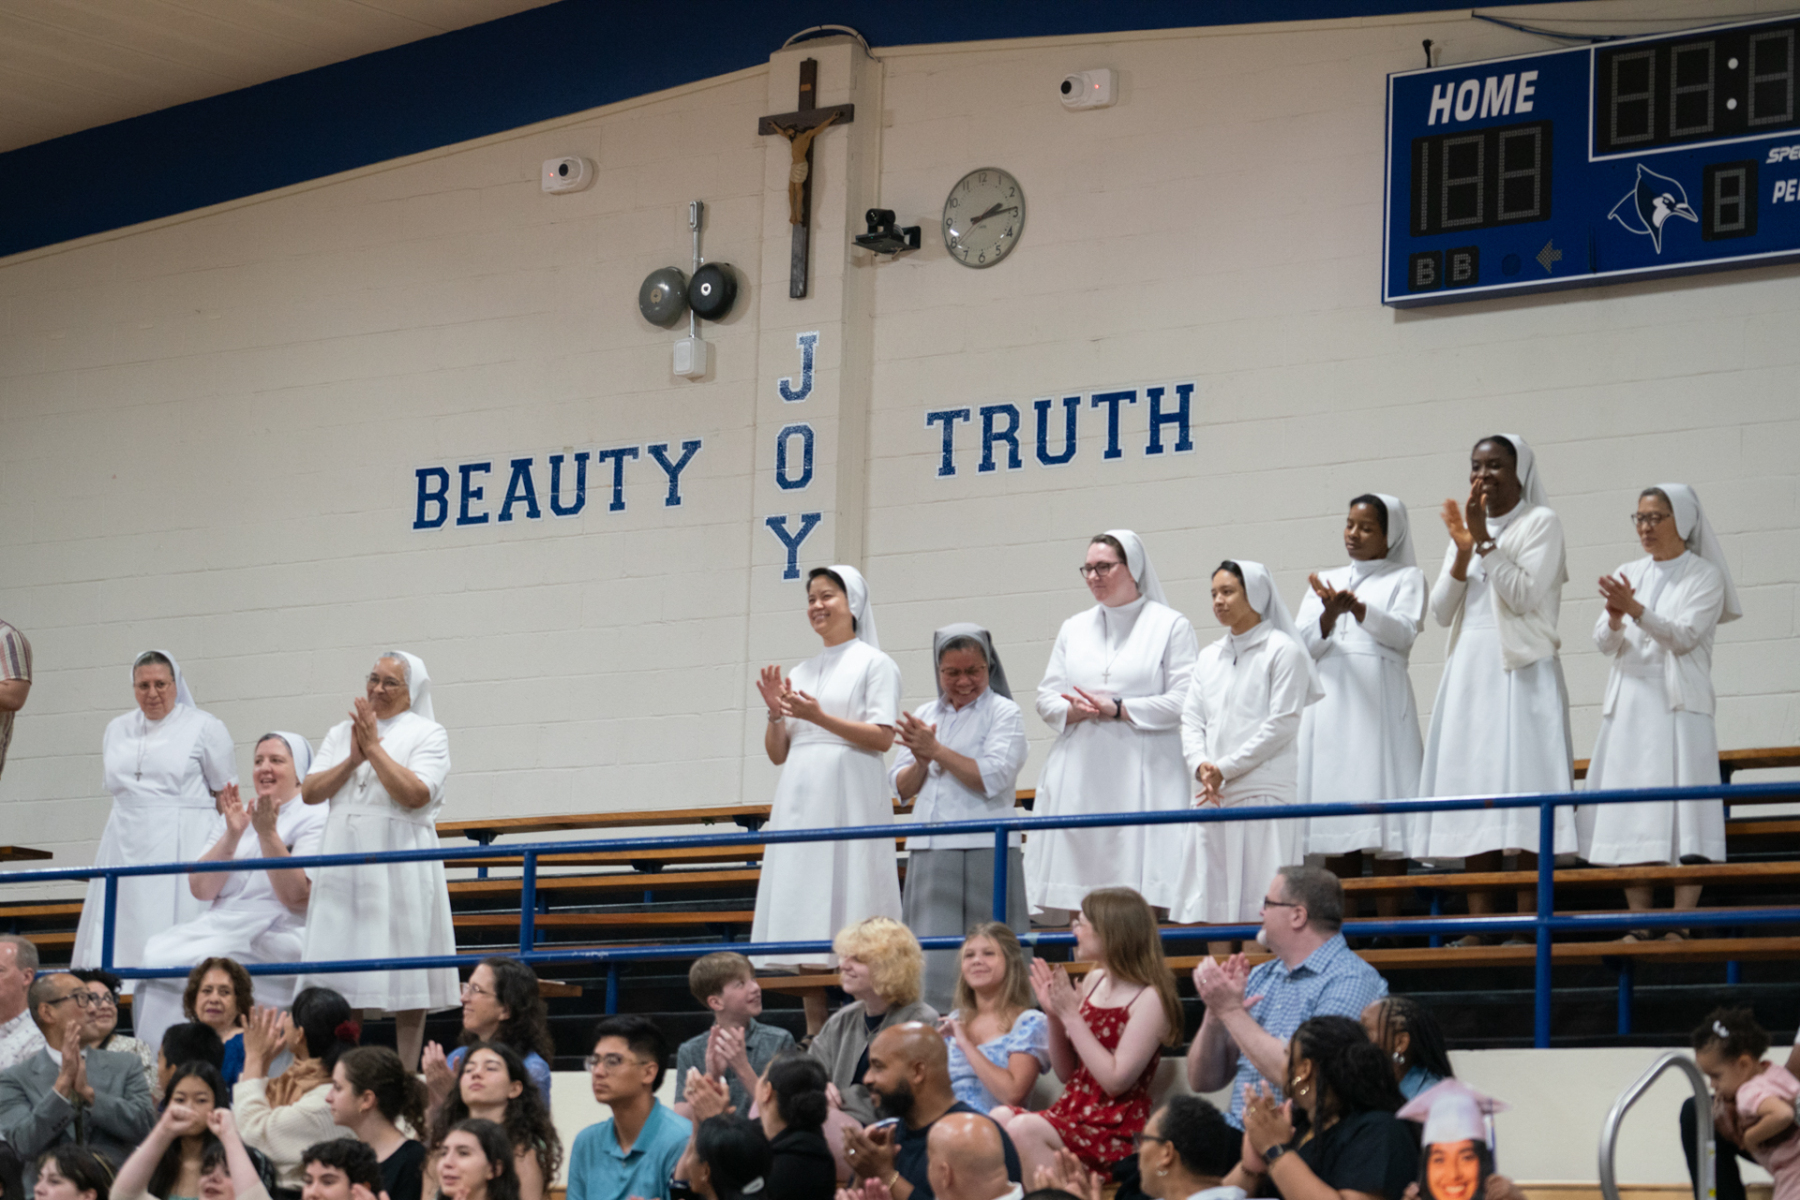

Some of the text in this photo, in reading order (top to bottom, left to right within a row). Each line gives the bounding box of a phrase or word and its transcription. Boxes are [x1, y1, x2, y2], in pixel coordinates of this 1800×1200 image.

[1427, 70, 1539, 126] HOME
[1765, 144, 1800, 164] SPE
[978, 171, 988, 183] 12
[962, 180, 970, 191] 11
[1008, 186, 1015, 197] 2
[949, 197, 958, 209] 10
[1012, 206, 1019, 218] 3
[945, 217, 953, 229] 9
[1005, 226, 1013, 237] 4
[950, 236, 958, 249] 8
[963, 249, 969, 261] 7
[995, 244, 1002, 256] 5
[978, 252, 986, 263] 6
[925, 381, 1197, 480] TRUTH
[764, 331, 823, 583] JOY
[411, 438, 703, 533] BEAUTY
